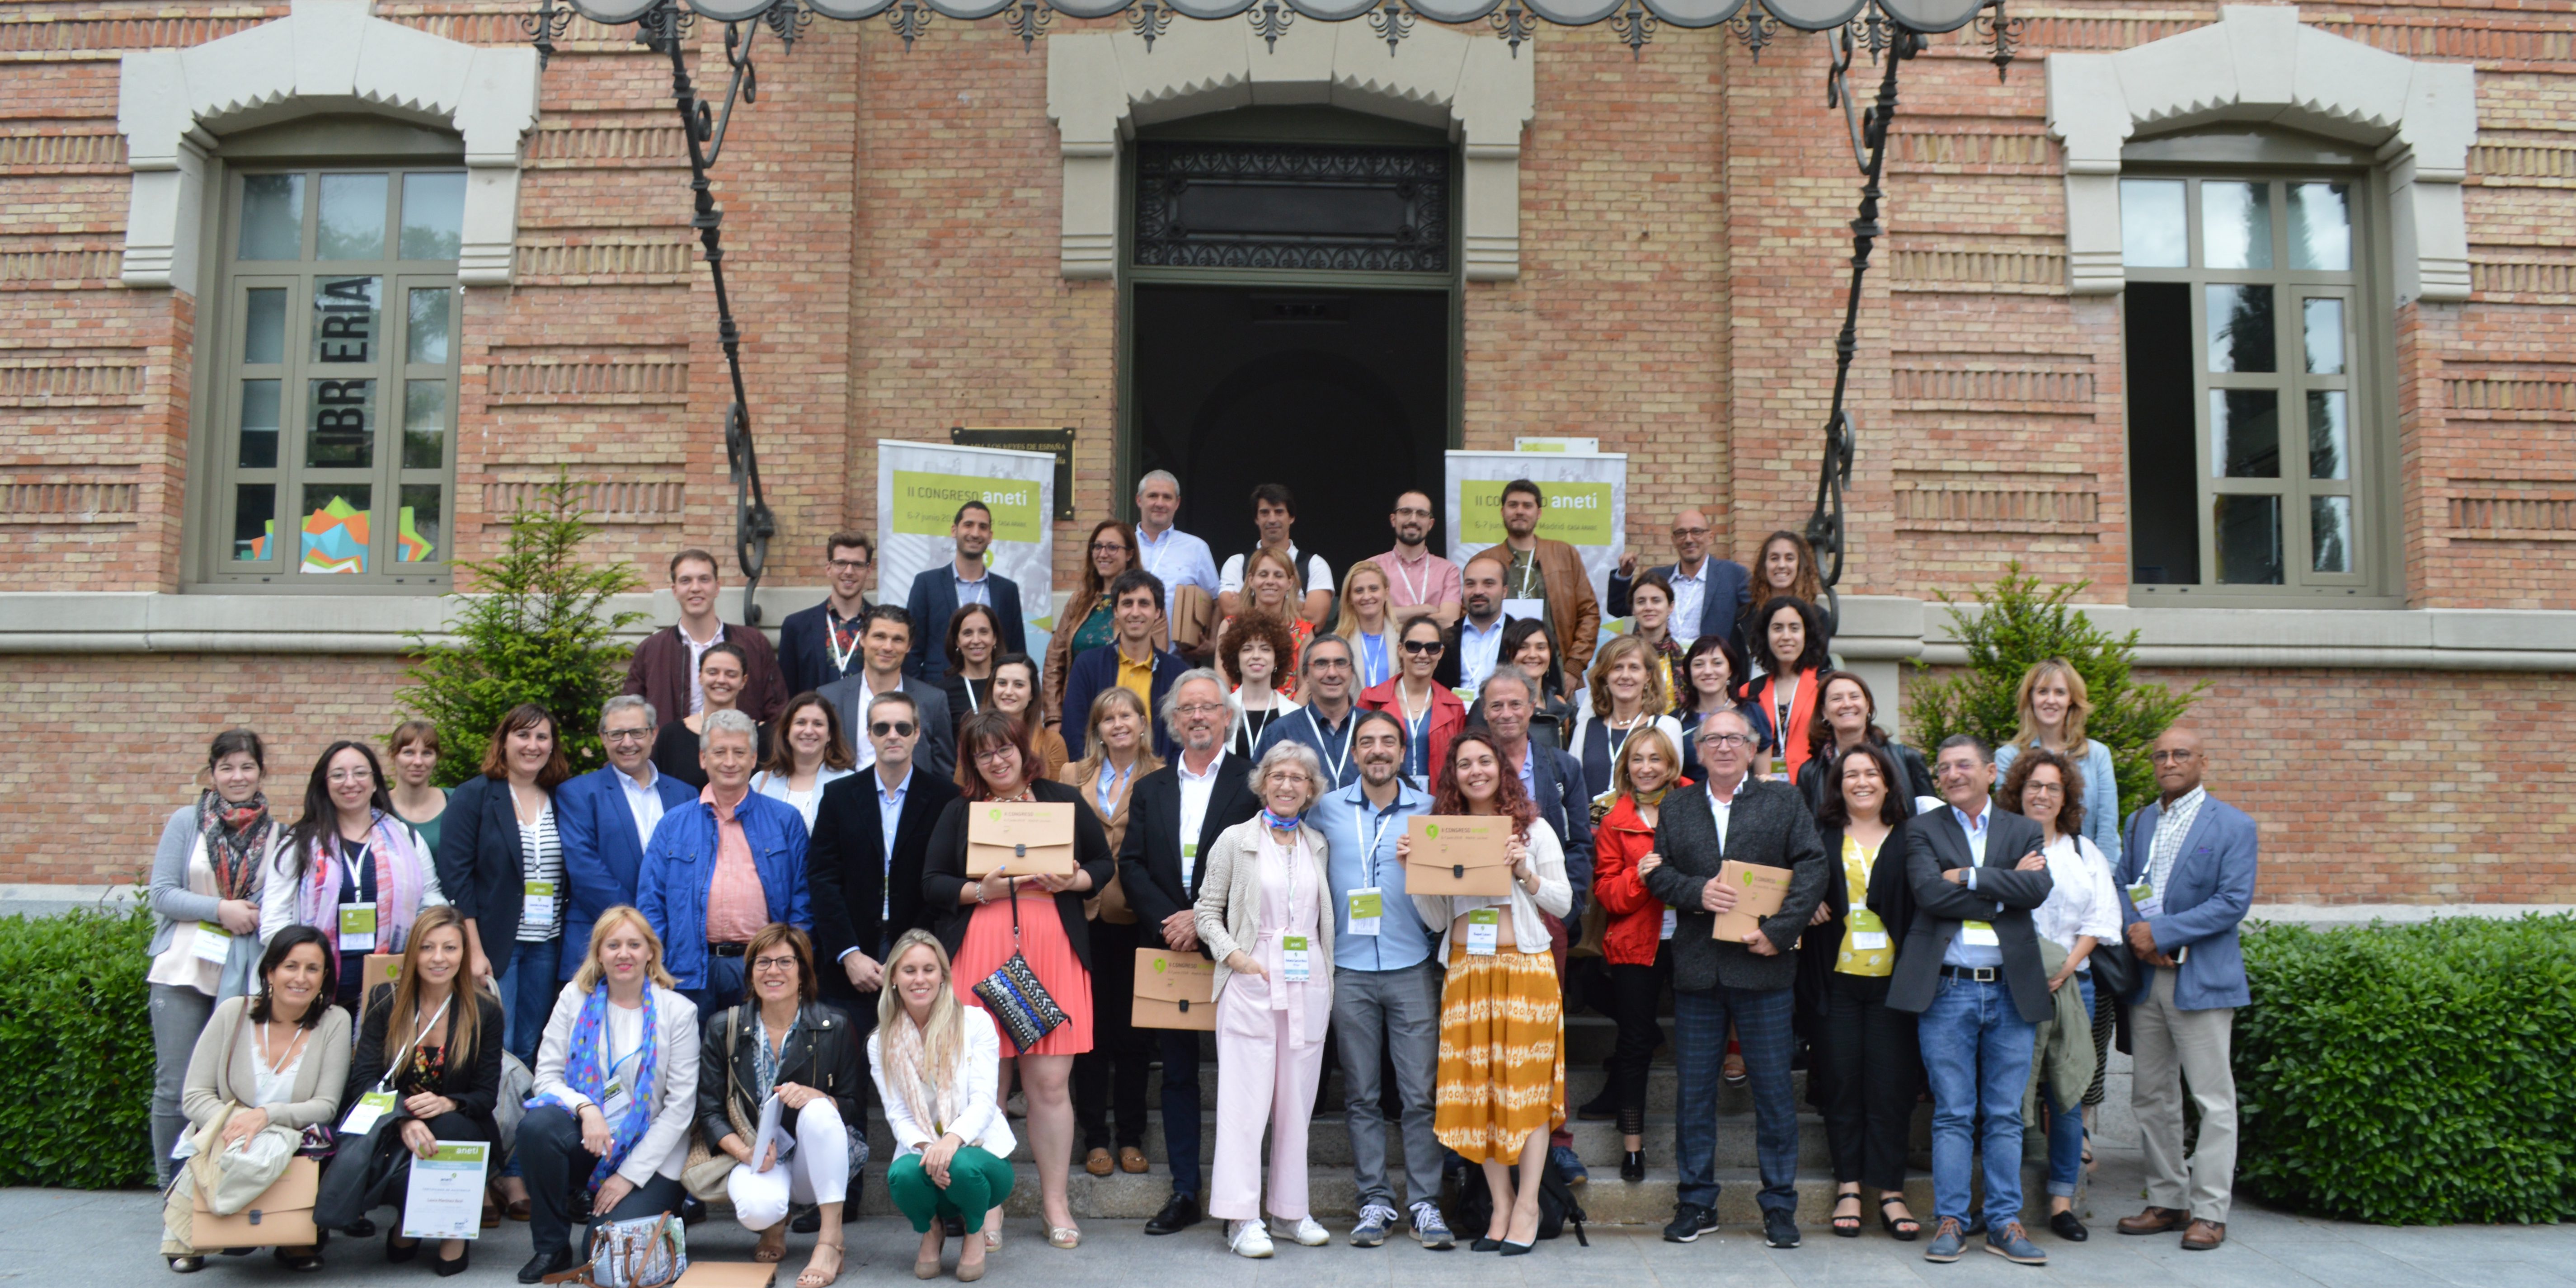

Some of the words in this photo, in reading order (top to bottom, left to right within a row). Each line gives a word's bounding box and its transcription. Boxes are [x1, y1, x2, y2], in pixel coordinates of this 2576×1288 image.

[315, 276, 372, 468] LIBRERÍA
[1039, 442, 1066, 451] ESPAÑA
[907, 486, 915, 497] II
[918, 487, 979, 502] CONGRESO
[982, 489, 1027, 506] aneti
[1476, 495, 1482, 506] II
[1551, 492, 1597, 509] aneti
[921, 512, 940, 522] junio
[1539, 521, 1565, 530] Madrid
[456, 1146, 479, 1155] aneti
